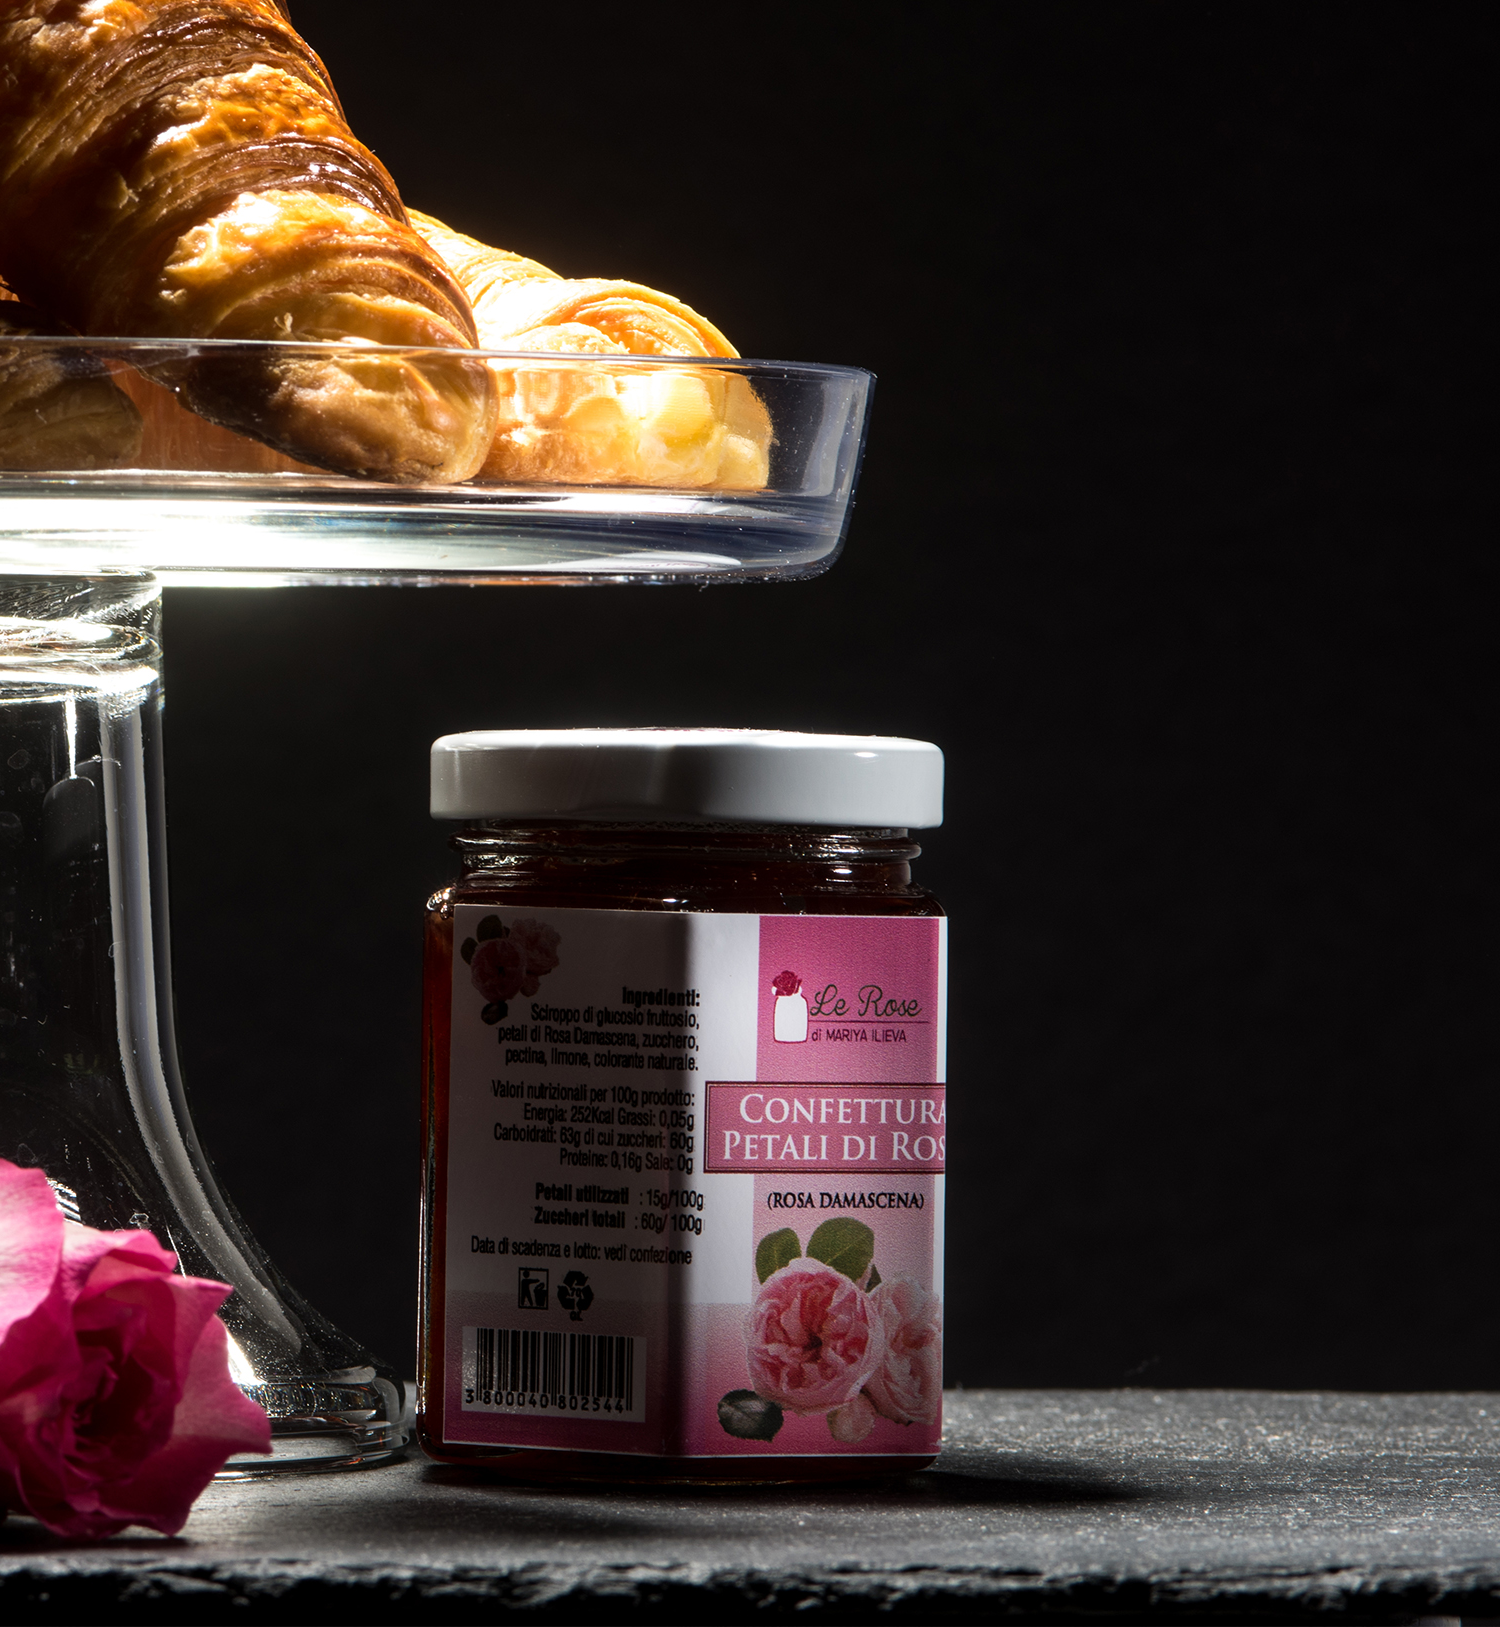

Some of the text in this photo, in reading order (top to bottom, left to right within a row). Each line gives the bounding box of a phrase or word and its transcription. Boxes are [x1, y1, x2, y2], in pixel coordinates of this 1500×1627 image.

[623, 987, 699, 1008] Ingredienti:
[810, 984, 922, 1017] Le Rose
[531, 1003, 699, 1029] Sciroppo di glucosio fruttosio,
[499, 1026, 698, 1051] petali di Rosa Damascena, zucchero,
[812, 1030, 907, 1042] di MARIYA ILIEVA
[506, 1047, 698, 1071] pectina, limone, colorante naturale.
[492, 1080, 694, 1107] Valori nutrizionali per 100g prodotto:
[524, 1103, 694, 1130] Energia: 252Kcal Grassi: 0,05g
[494, 1124, 693, 1152] Carboidrati: 63g di cui zuccheri: 60g
[723, 1130, 828, 1160] PETALI
[842, 1136, 877, 1160] DI
[560, 1149, 693, 1174] Proteine: 0,16g Sale: 0g
[536, 1183, 572, 1201] Petali
[576, 1185, 629, 1204] utilizzati
[768, 1192, 924, 1209] (ROSA DAMASCENA)
[534, 1207, 588, 1226] Zuccheri
[593, 1210, 625, 1228] totali
[471, 1236, 692, 1264] Data di scadenza e lotto: vedi confezione
